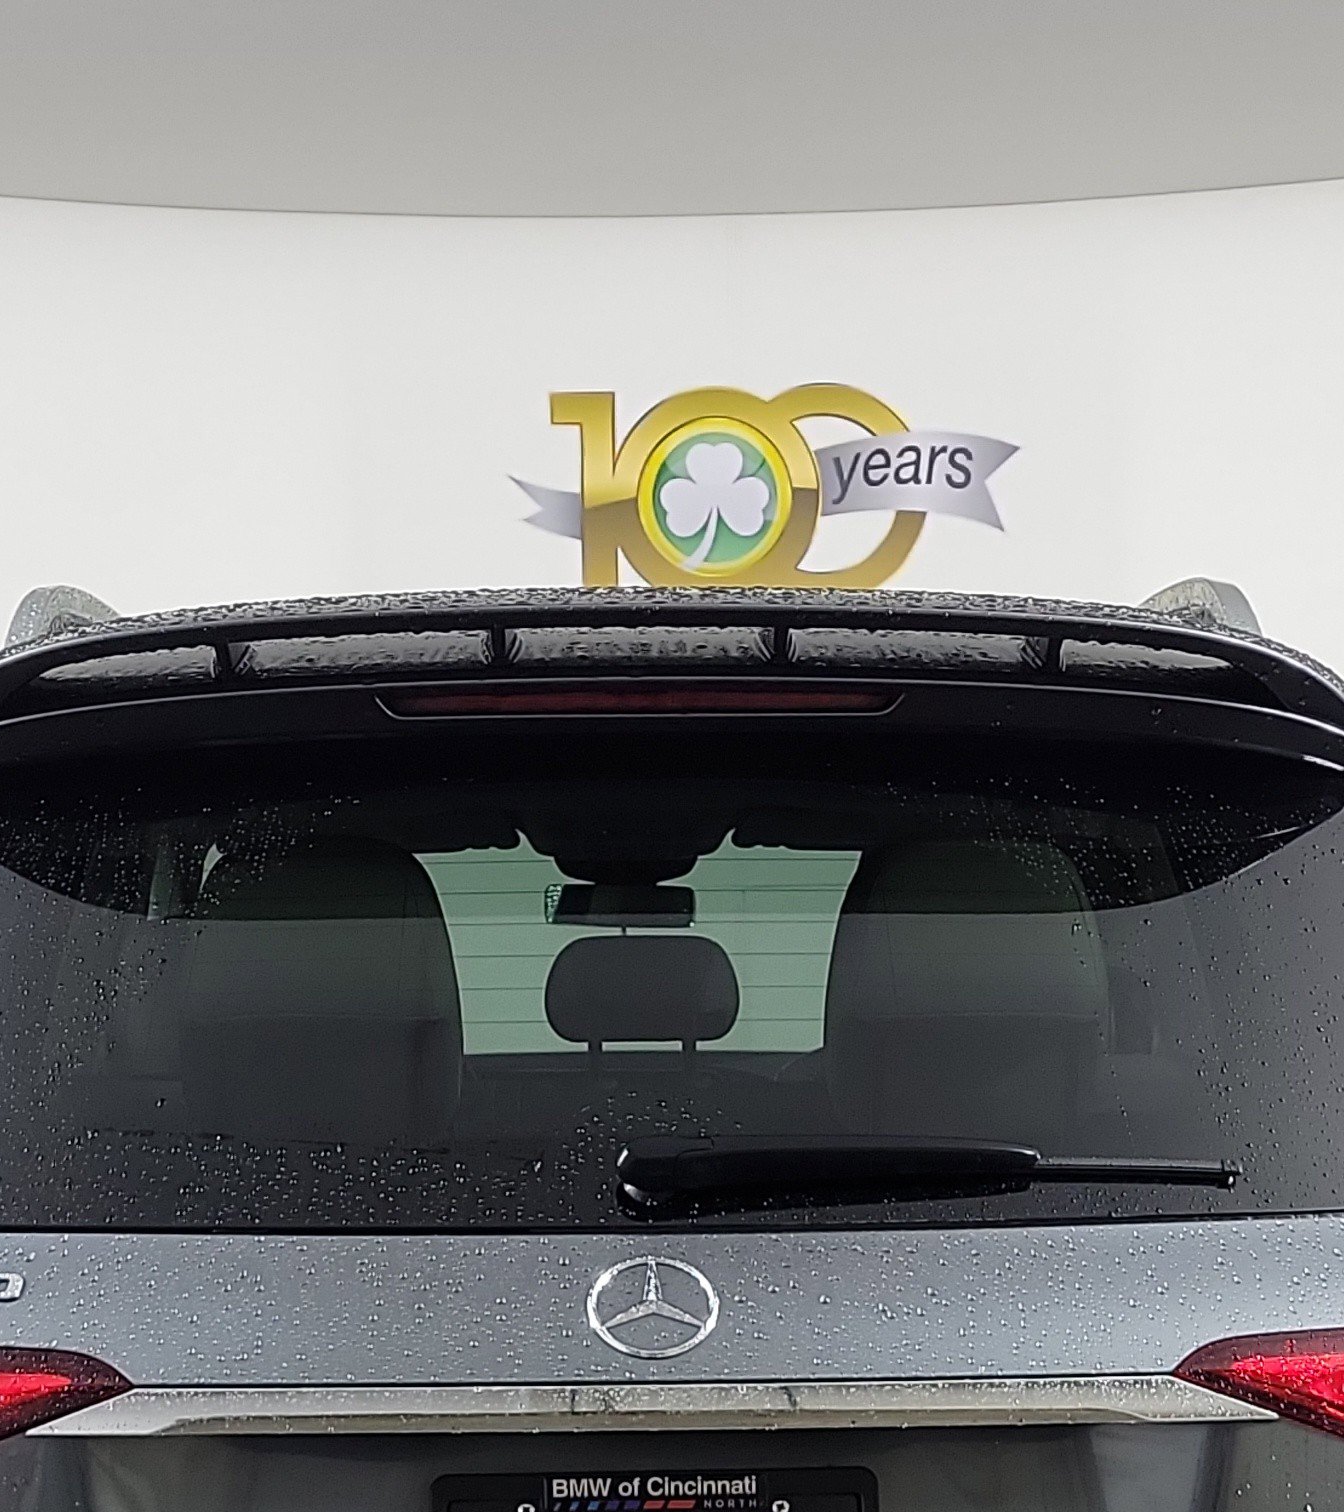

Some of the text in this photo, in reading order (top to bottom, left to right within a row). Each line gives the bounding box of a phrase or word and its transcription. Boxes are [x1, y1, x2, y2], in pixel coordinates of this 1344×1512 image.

[831, 444, 974, 505] years
[552, 1475, 757, 1498] BMW of Cincinnati
[703, 1498, 757, 1509] NORTH
